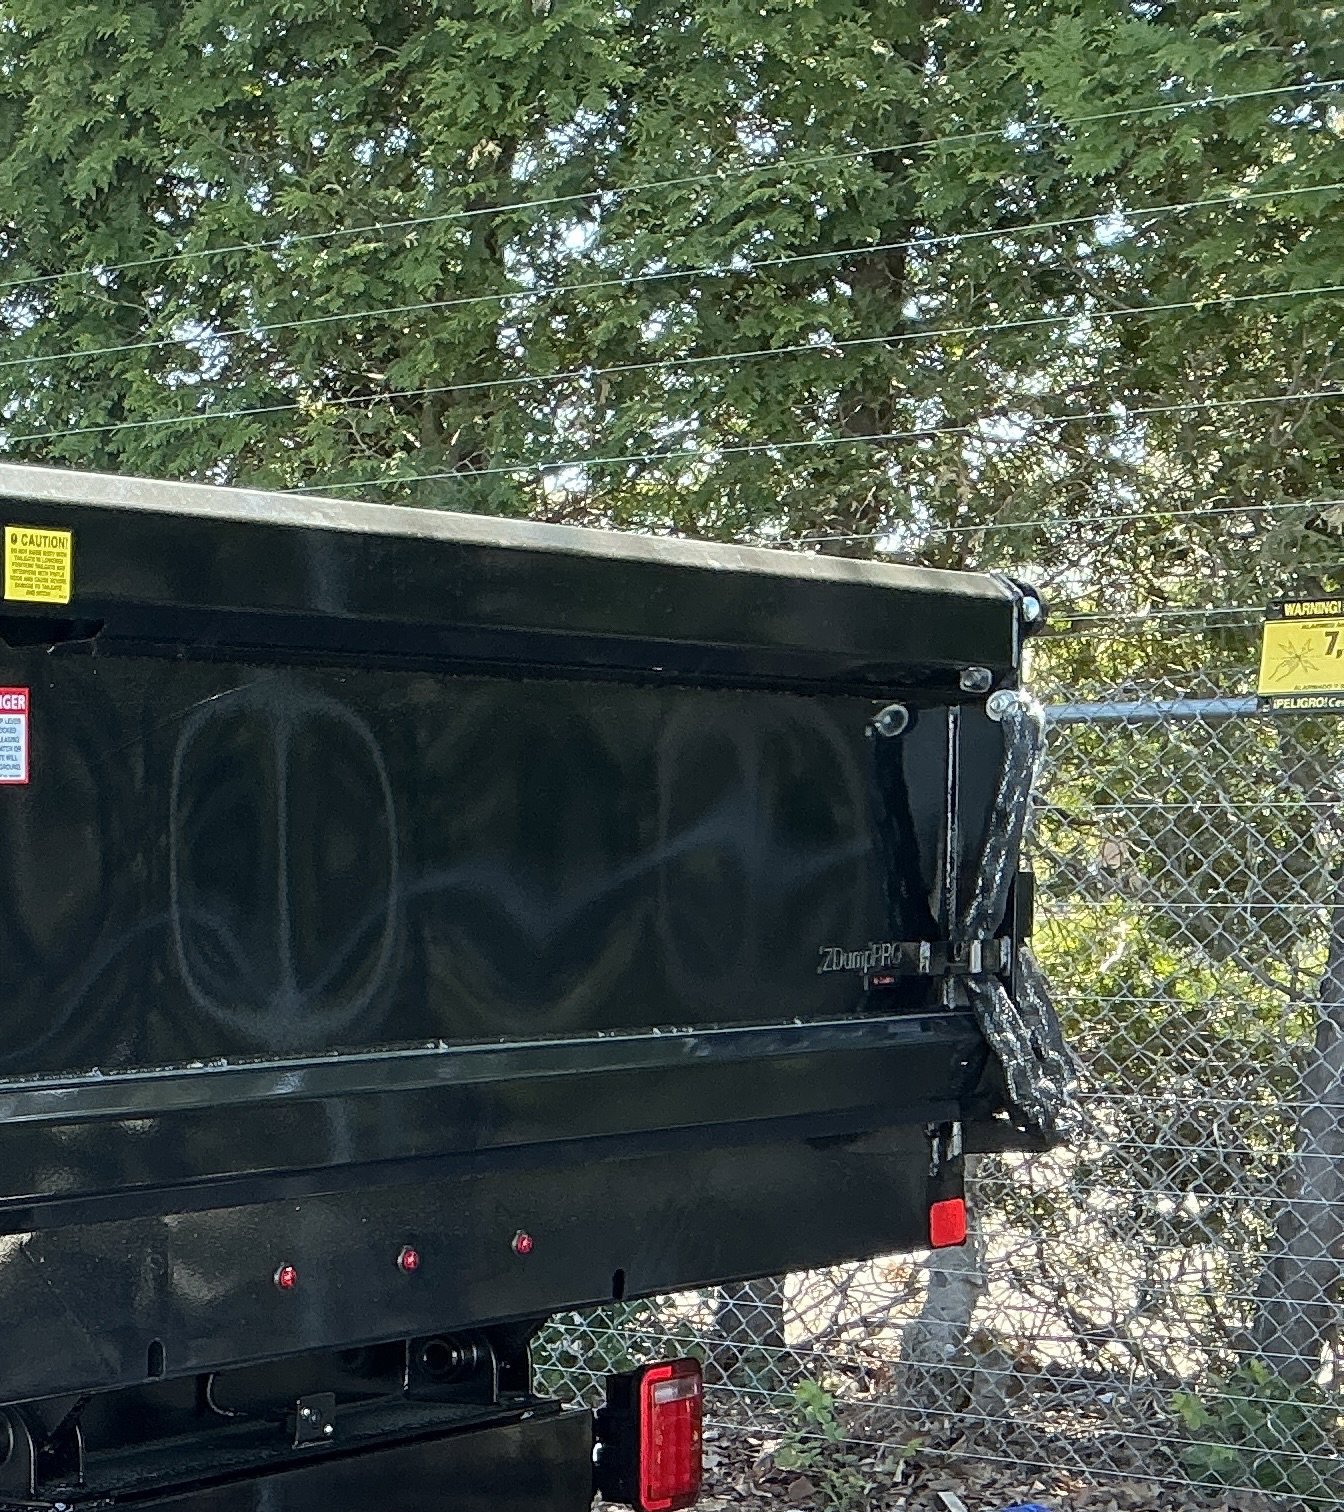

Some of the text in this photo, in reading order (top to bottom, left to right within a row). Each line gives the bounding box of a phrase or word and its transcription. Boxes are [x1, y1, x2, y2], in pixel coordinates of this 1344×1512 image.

[21, 533, 68, 549] CAUTION!
[1284, 601, 1342, 616] WARNING!
[1273, 697, 1328, 710] ¡PELIGRO!
